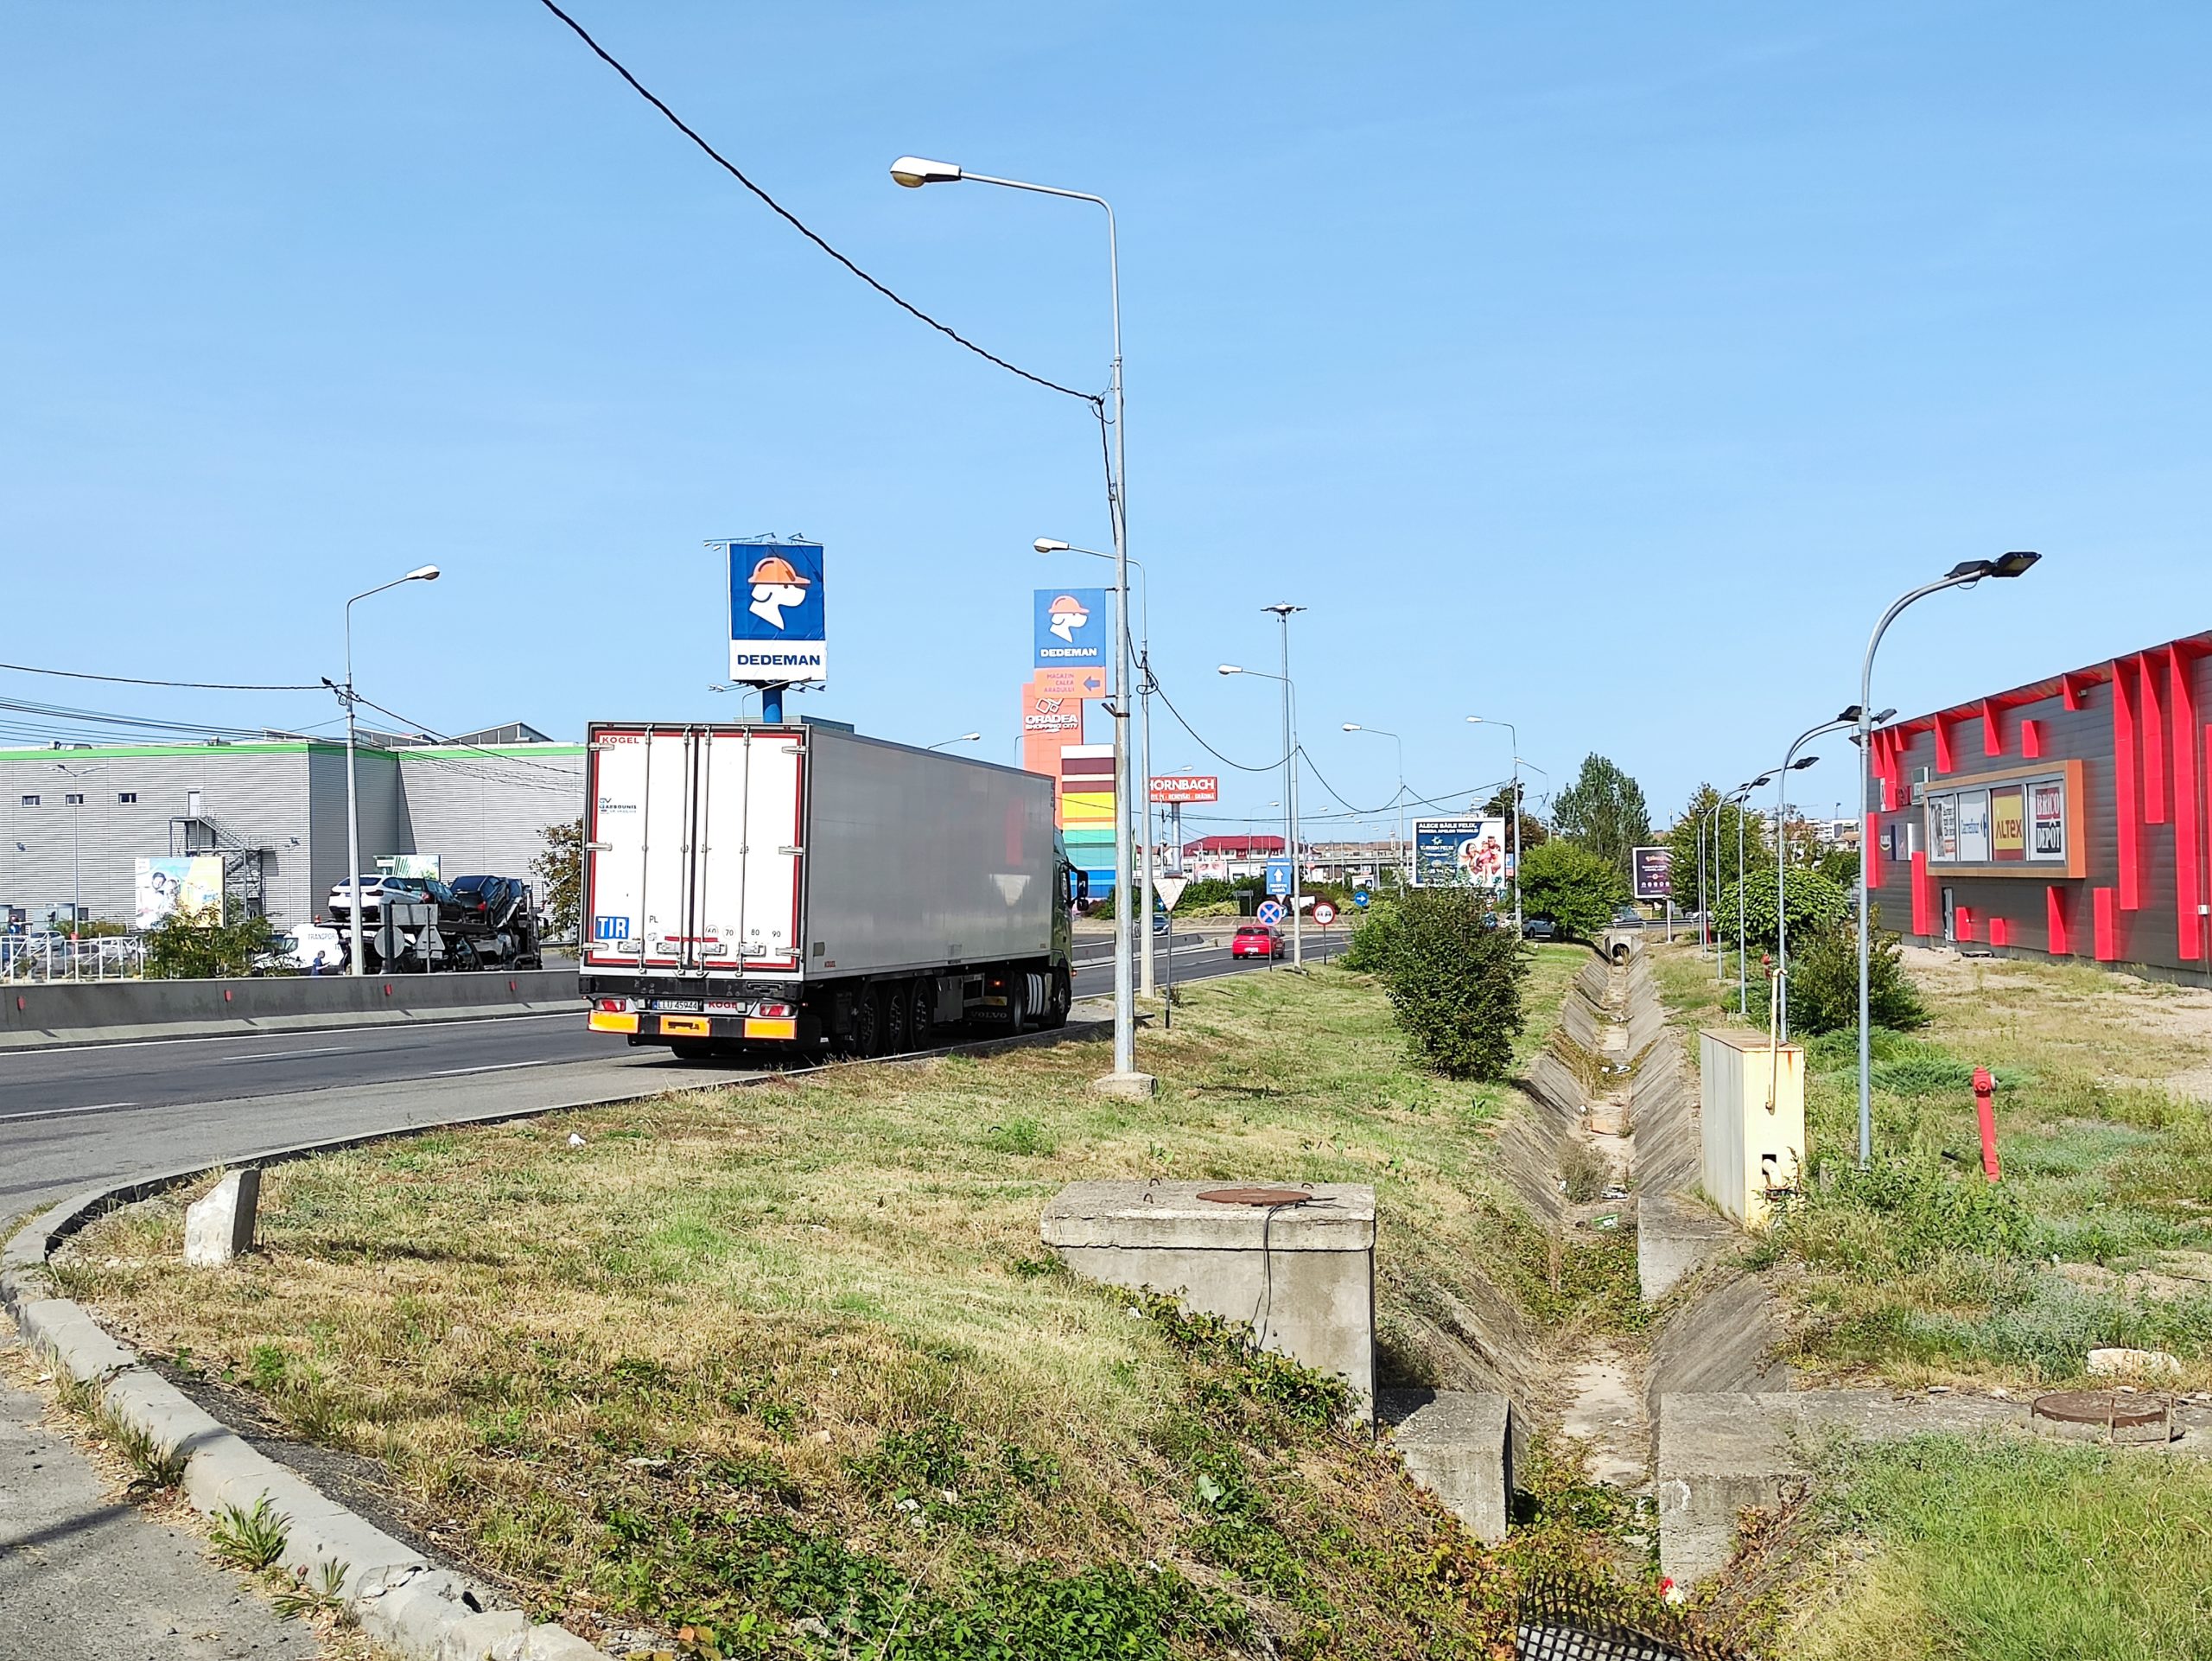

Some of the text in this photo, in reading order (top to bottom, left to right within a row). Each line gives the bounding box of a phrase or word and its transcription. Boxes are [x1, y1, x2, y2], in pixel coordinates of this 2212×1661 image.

[1040, 648, 1097, 658] DEDEMAN
[737, 654, 821, 665] DEDEMAN
[1025, 714, 1078, 724] ORADEA
[2037, 792, 2060, 816] BRICO
[598, 917, 626, 938] TIR
[970, 1010, 1007, 1019] VOLVO
